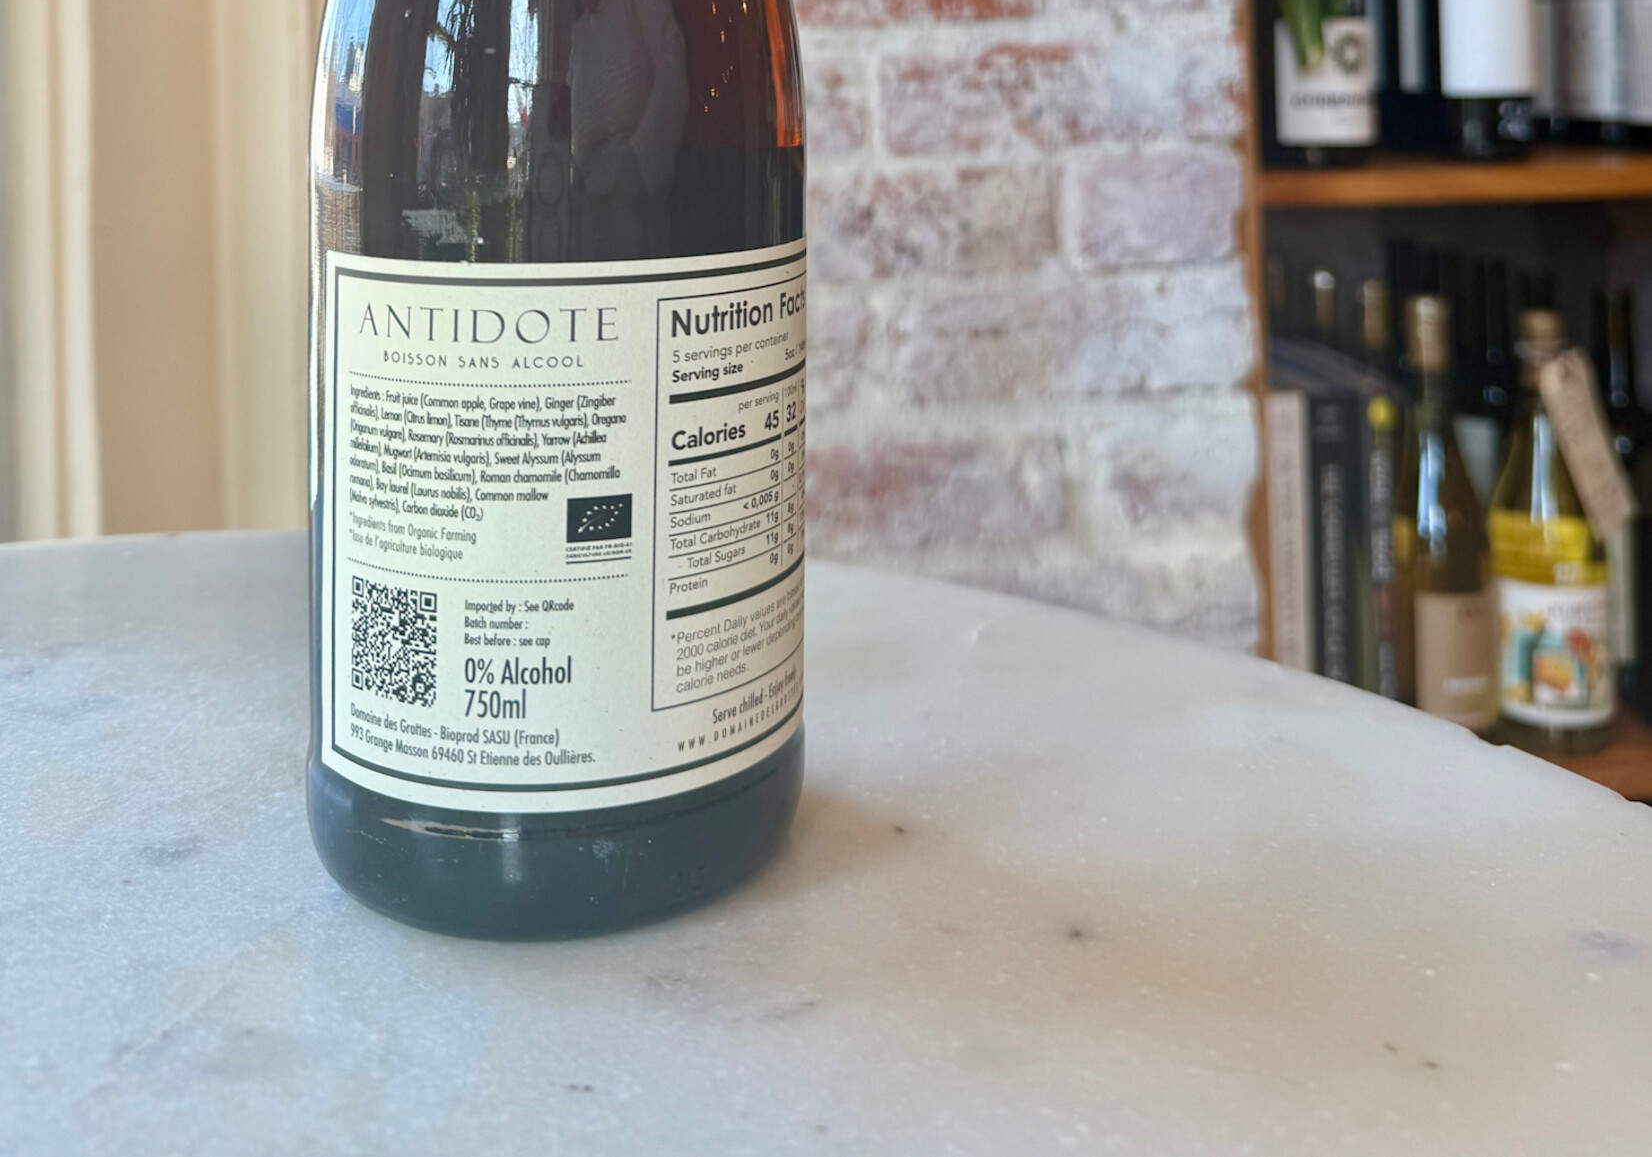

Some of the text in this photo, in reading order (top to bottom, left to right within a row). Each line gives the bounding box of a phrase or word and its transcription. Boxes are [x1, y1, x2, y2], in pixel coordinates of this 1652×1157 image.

[360, 302, 619, 344] ANTIDOTE
[671, 300, 773, 338] Nutrition
[384, 351, 584, 369] BOISSON SANS ALCOOL
[672, 350, 681, 363] 5
[684, 345, 733, 362] servings
[735, 342, 753, 357] per
[754, 332, 789, 350] container
[672, 362, 743, 383] Serving size
[386, 390, 401, 404] Fruit
[402, 392, 418, 407] juice
[420, 393, 459, 409] (Common
[461, 396, 486, 412] apple,
[490, 397, 515, 413] Grape
[517, 396, 542, 413] vine),
[545, 396, 574, 412] Ginger
[577, 393, 616, 411] (Zingiber
[738, 391, 780, 414] per serving
[381, 407, 402, 422] Lemon
[404, 409, 425, 425] (Citrus
[427, 411, 452, 429] limon),
[454, 414, 479, 427] Tisane
[481, 414, 512, 431] (Thyme
[514, 414, 551, 431] (Thymus
[551, 413, 589, 430] vulgaris),
[591, 413, 626, 428] Oregano
[671, 401, 797, 451] Calories 45 32
[408, 429, 444, 447] Rosemary
[445, 431, 494, 447] (Rosmarinus
[496, 432, 539, 449] officinalis),
[541, 433, 570, 445] Yarrow
[572, 430, 607, 448] (Achillea
[414, 446, 451, 462] (Artemisia
[453, 449, 491, 467] vulgaris),
[494, 452, 520, 465] Sweet
[522, 450, 559, 467] Alyssum
[561, 449, 601, 466] (Alyssum
[671, 469, 698, 485] Total
[700, 466, 717, 480] Fat
[770, 448, 779, 461] 0g
[382, 461, 397, 476] Basil
[399, 462, 432, 479] (Ocimum
[434, 466, 478, 485] basilicum),
[480, 469, 511, 483] Roman
[513, 468, 562, 483] chamomile
[564, 465, 620, 485] (Chamomilla
[376, 477, 388, 494] Bay
[389, 479, 409, 495] laurel
[411, 482, 439, 499] (Laurus
[441, 486, 473, 503] nobilis),
[475, 487, 514, 502] Common
[516, 487, 549, 501] mallow
[670, 486, 721, 507] Saturated
[724, 482, 737, 496] fat
[770, 469, 779, 482] 0g
[402, 500, 429, 515] Carbon
[430, 502, 459, 519] dioxide
[670, 510, 711, 529] Sodium
[388, 519, 406, 536] from
[407, 523, 438, 541] Organic
[440, 527, 477, 546] Farming
[670, 534, 697, 551] Total
[699, 518, 761, 545] Carbohydrate
[365, 532, 373, 547] de
[419, 542, 464, 563] biologique
[687, 552, 712, 569] Total
[714, 546, 746, 563] Sugars
[669, 577, 708, 595] Protein
[464, 599, 574, 615] Imported by See QRcode
[723, 614, 749, 633] Daily
[750, 602, 775, 622] values
[464, 616, 523, 631] Batch number
[464, 632, 551, 650] Best before see cap
[676, 645, 704, 661] 2000
[707, 635, 738, 654] calorie
[759, 616, 776, 634] Your
[464, 655, 572, 685] 0% Alcohol
[676, 664, 692, 677] be
[695, 654, 729, 673] higher
[731, 649, 741, 662] or
[676, 661, 749, 693] calorie needs.
[464, 688, 526, 719] 750ml
[712, 705, 737, 725] Serve
[738, 687, 764, 714] chilled
[351, 702, 560, 748] Domaine des Grottes Bioprod SASU (France)
[350, 724, 364, 741] 993
[365, 730, 393, 752] Grange
[395, 738, 429, 759] Masson
[431, 745, 464, 764] 69460
[467, 749, 477, 765] St
[480, 749, 520, 766] Etienne
[523, 749, 542, 766] des
